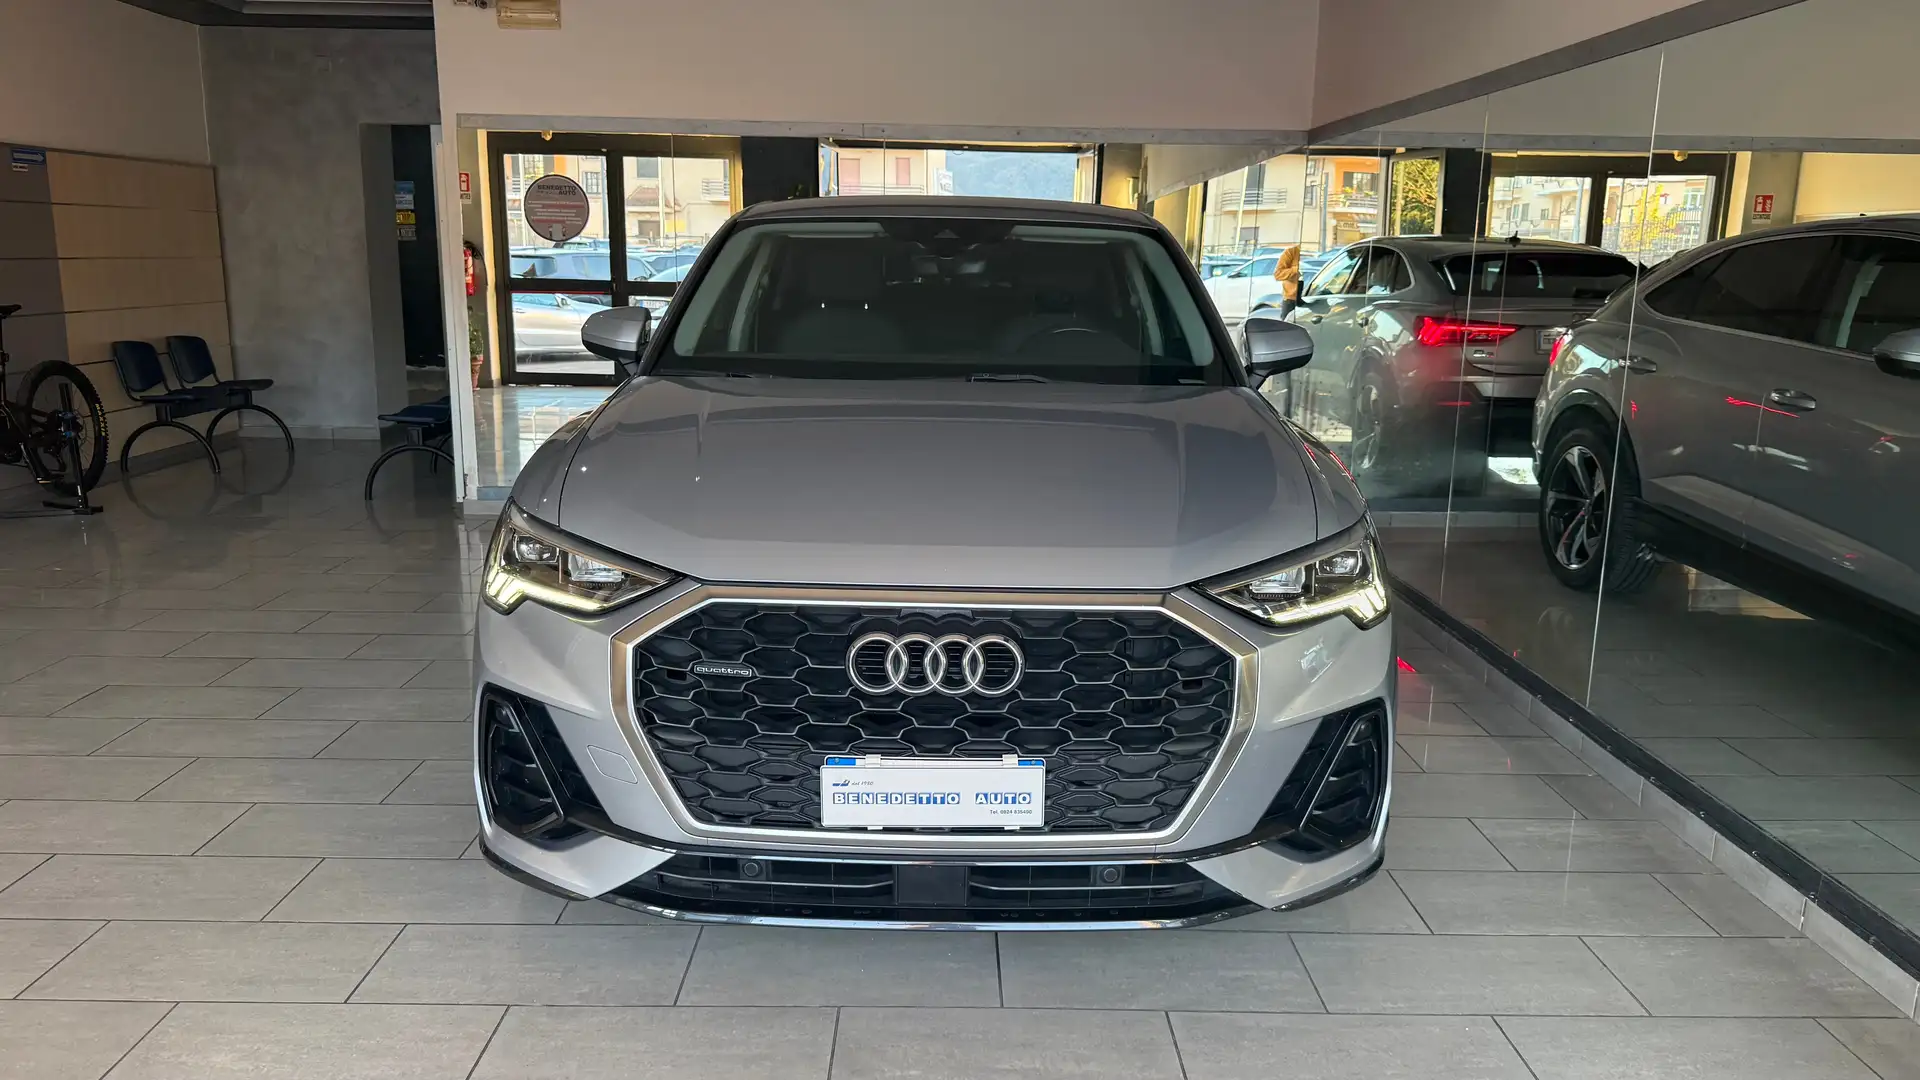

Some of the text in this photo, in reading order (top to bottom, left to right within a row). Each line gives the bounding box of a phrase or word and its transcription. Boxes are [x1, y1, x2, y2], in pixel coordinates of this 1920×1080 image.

[696, 666, 749, 675] quattro
[833, 792, 1032, 804] BENEDETTO AUTO
